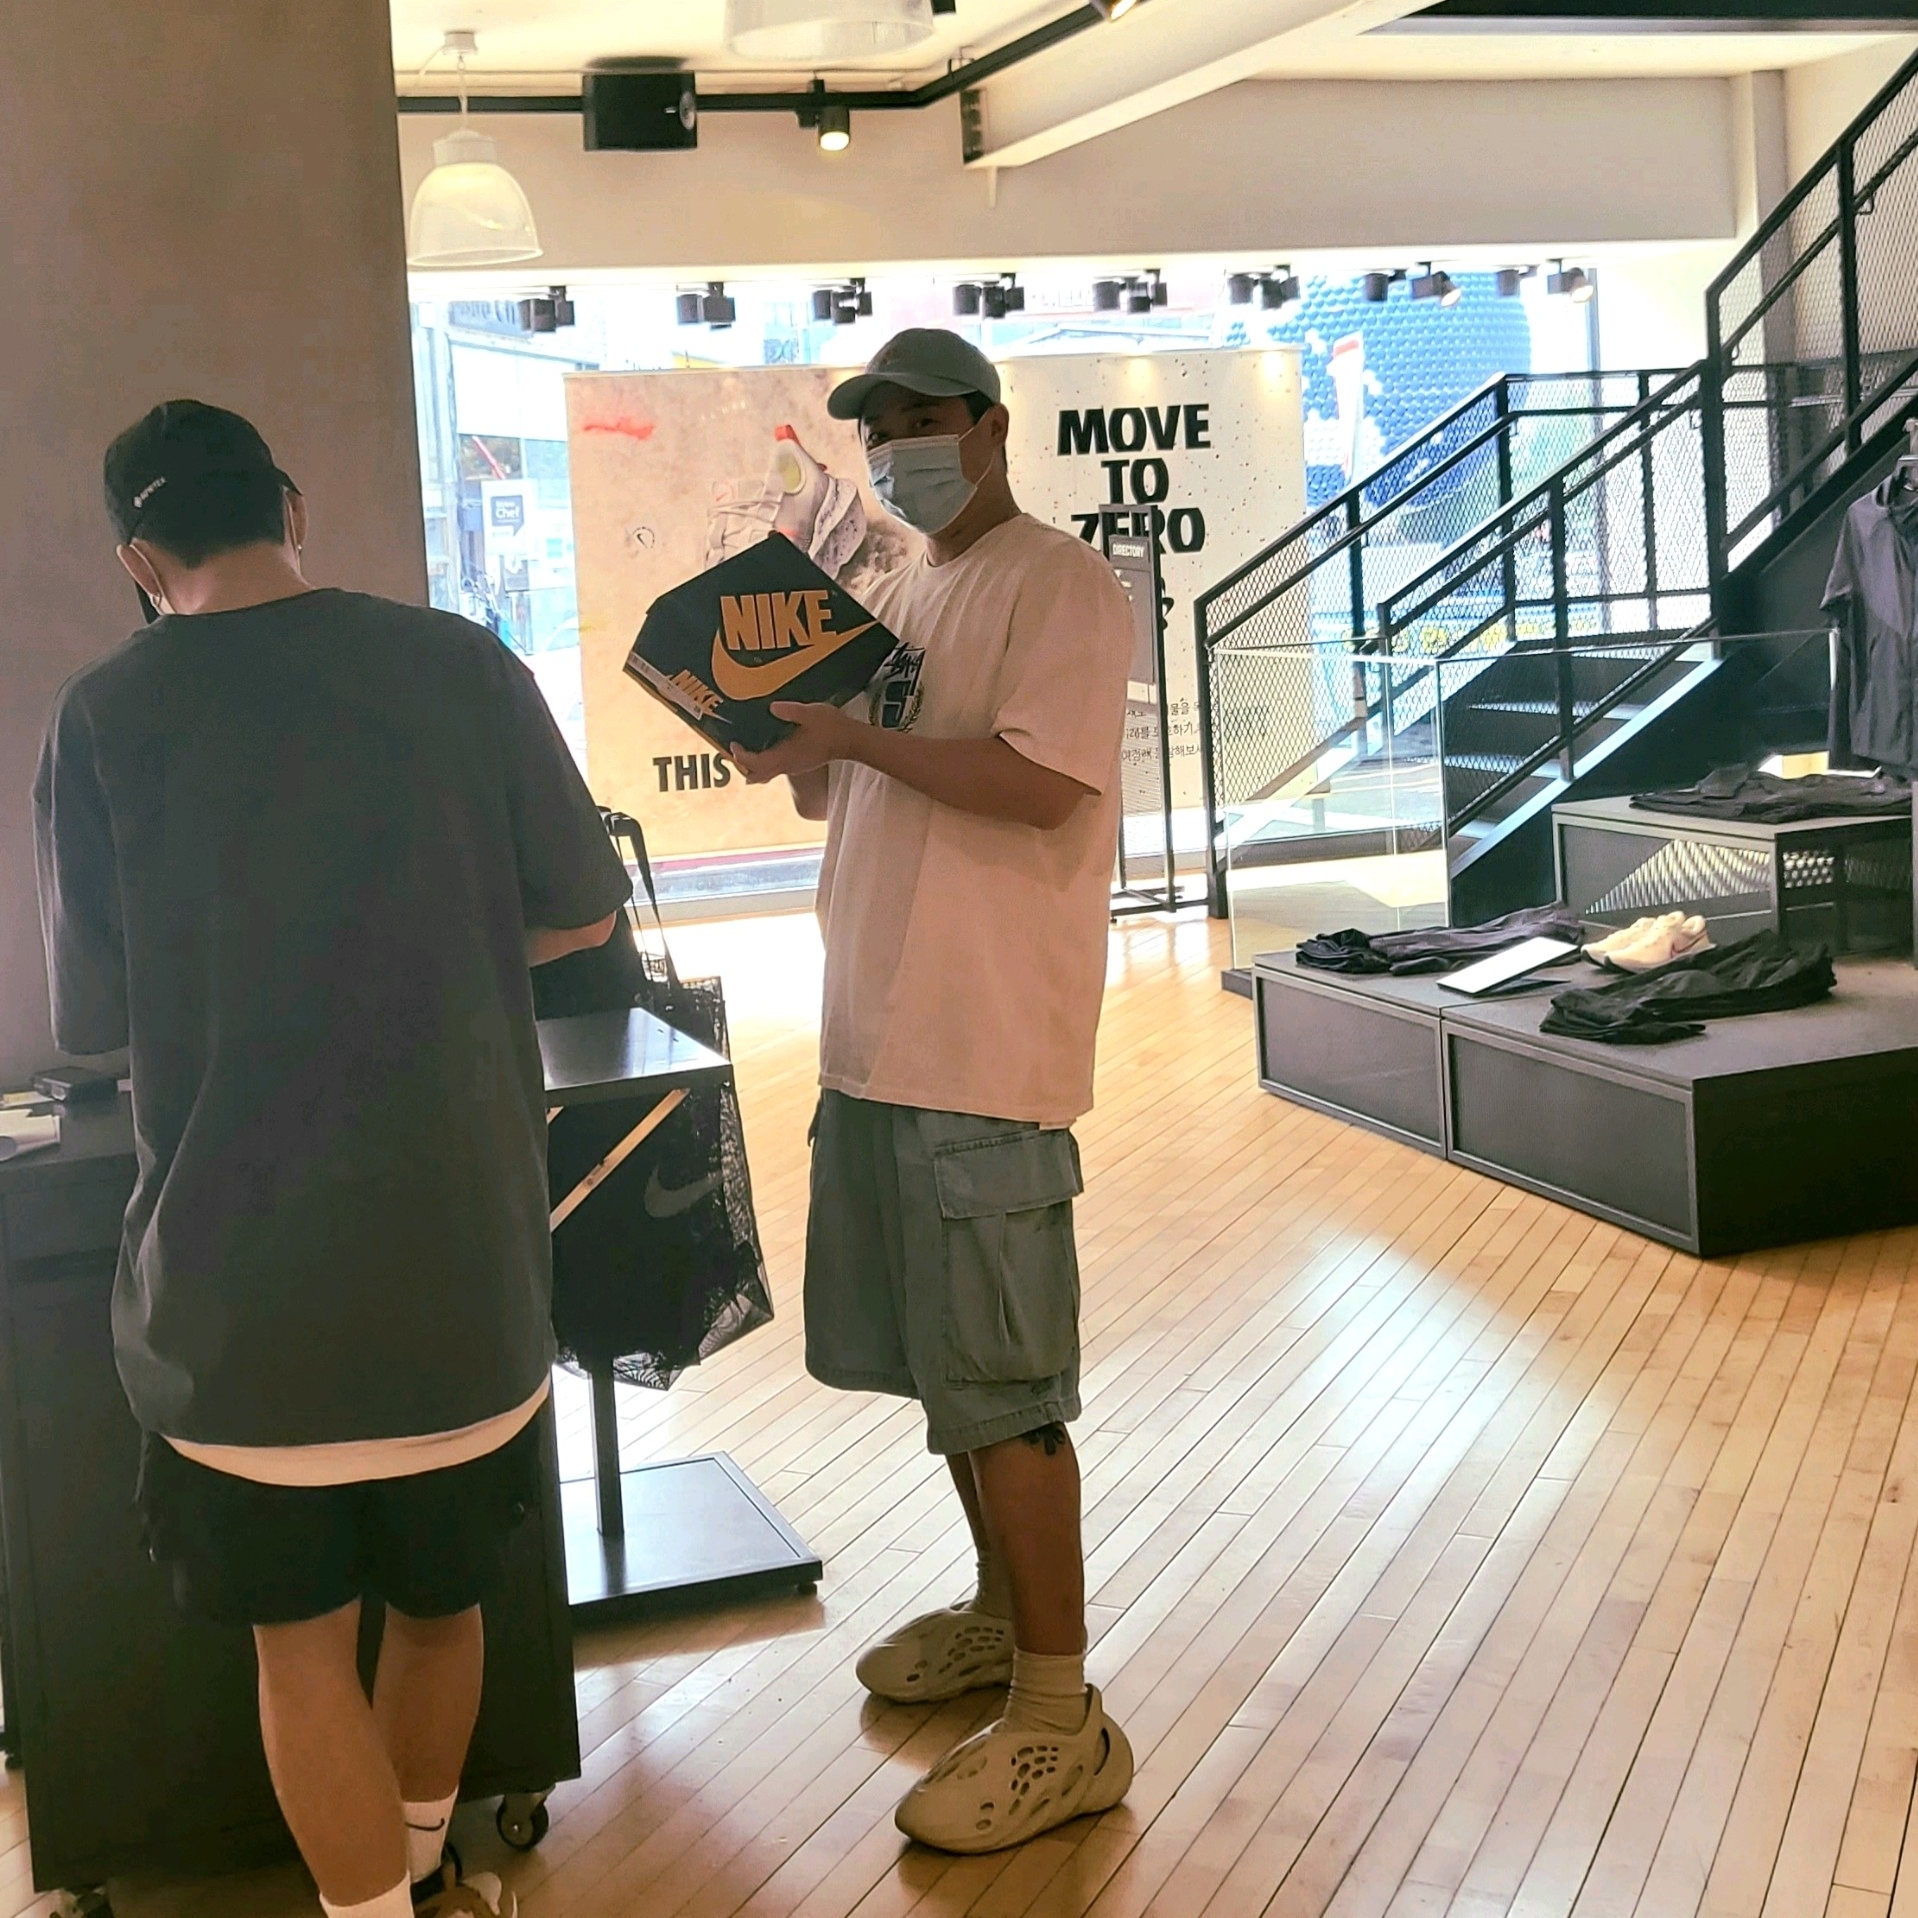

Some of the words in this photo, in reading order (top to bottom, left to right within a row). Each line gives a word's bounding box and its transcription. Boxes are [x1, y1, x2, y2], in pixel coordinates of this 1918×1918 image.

[1057, 403, 1211, 456] MOVE
[1100, 457, 1169, 505] TO
[1112, 543, 1144, 557] DIRECTORY
[720, 590, 834, 651] NIKE
[669, 669, 724, 712] NIKE
[652, 752, 731, 792] THIS
